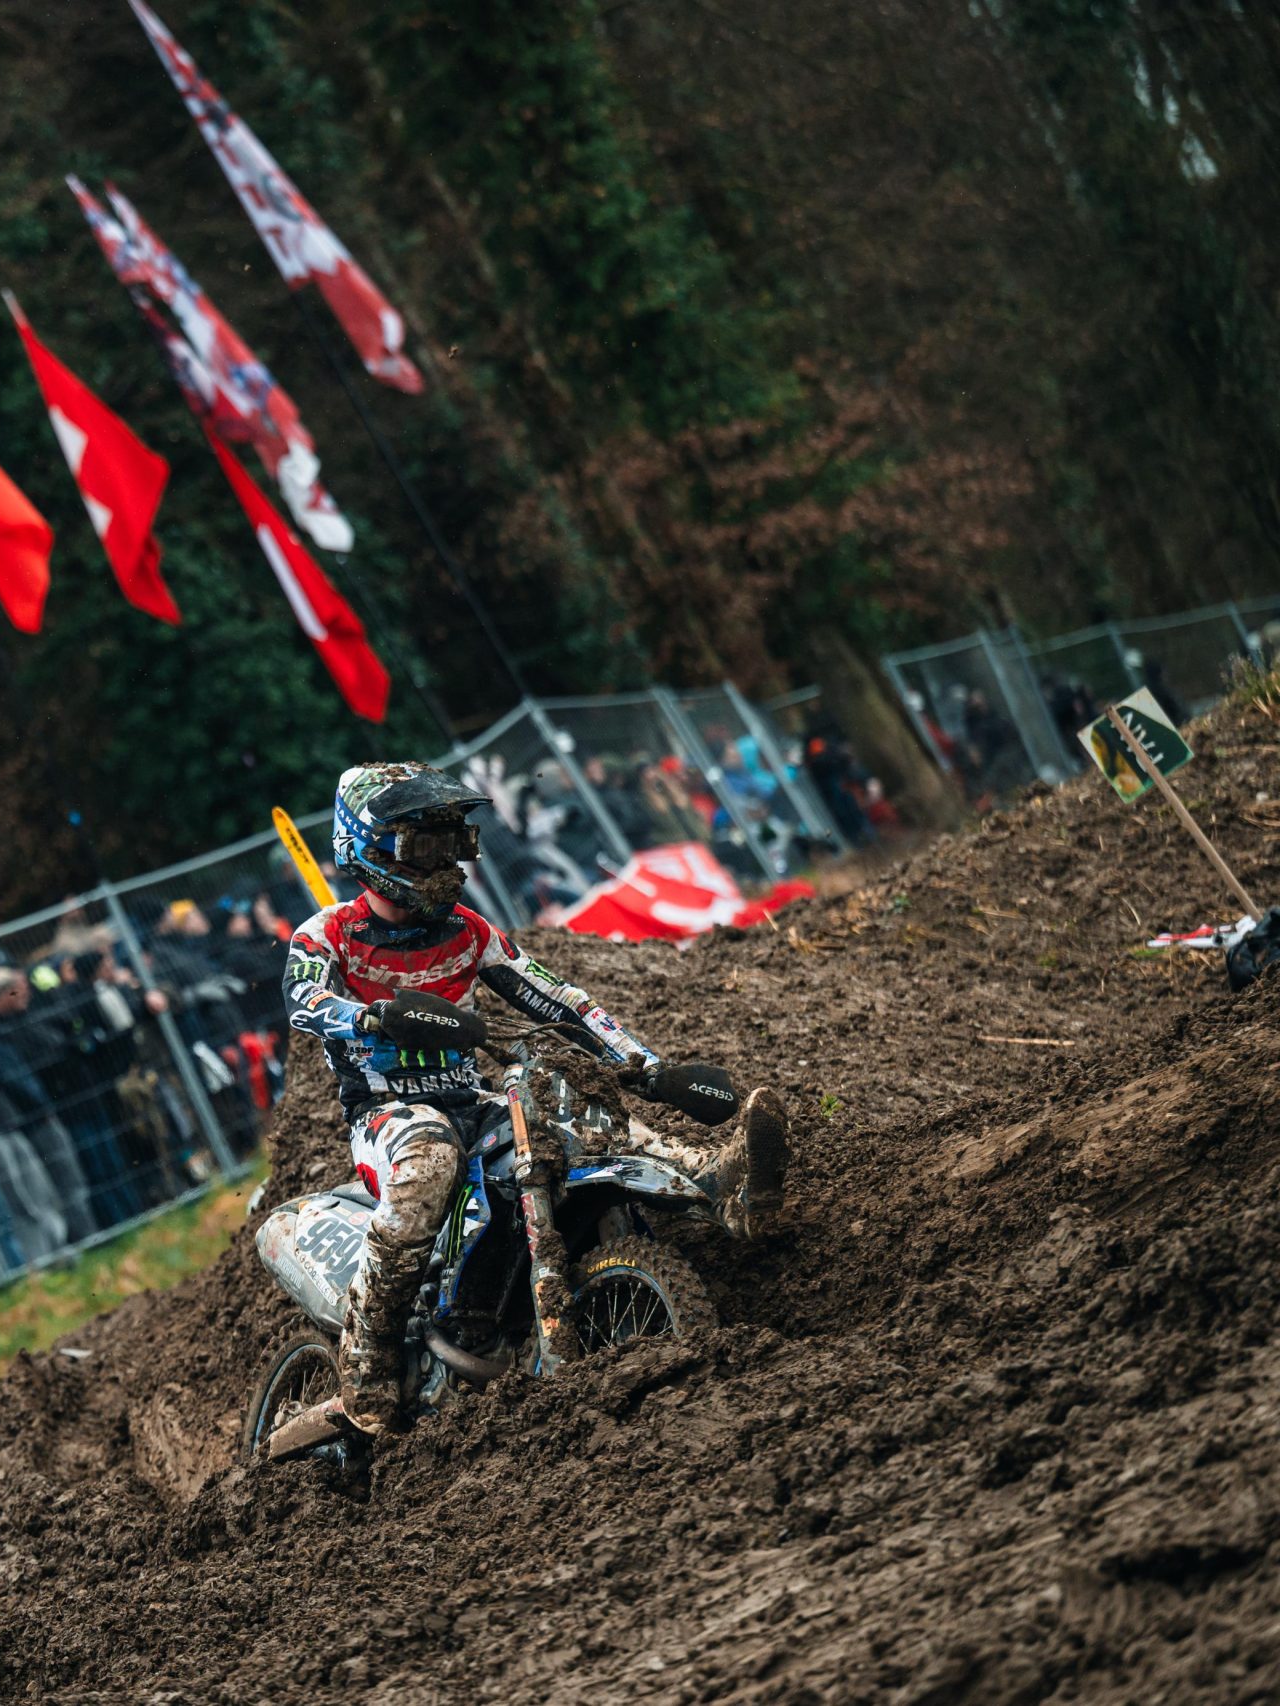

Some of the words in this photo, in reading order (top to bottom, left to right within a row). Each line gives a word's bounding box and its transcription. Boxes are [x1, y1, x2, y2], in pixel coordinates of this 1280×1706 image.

[514, 982, 564, 1023] YAMAHA
[297, 1217, 364, 1272] 959
[587, 1256, 637, 1274] PIRELLI
